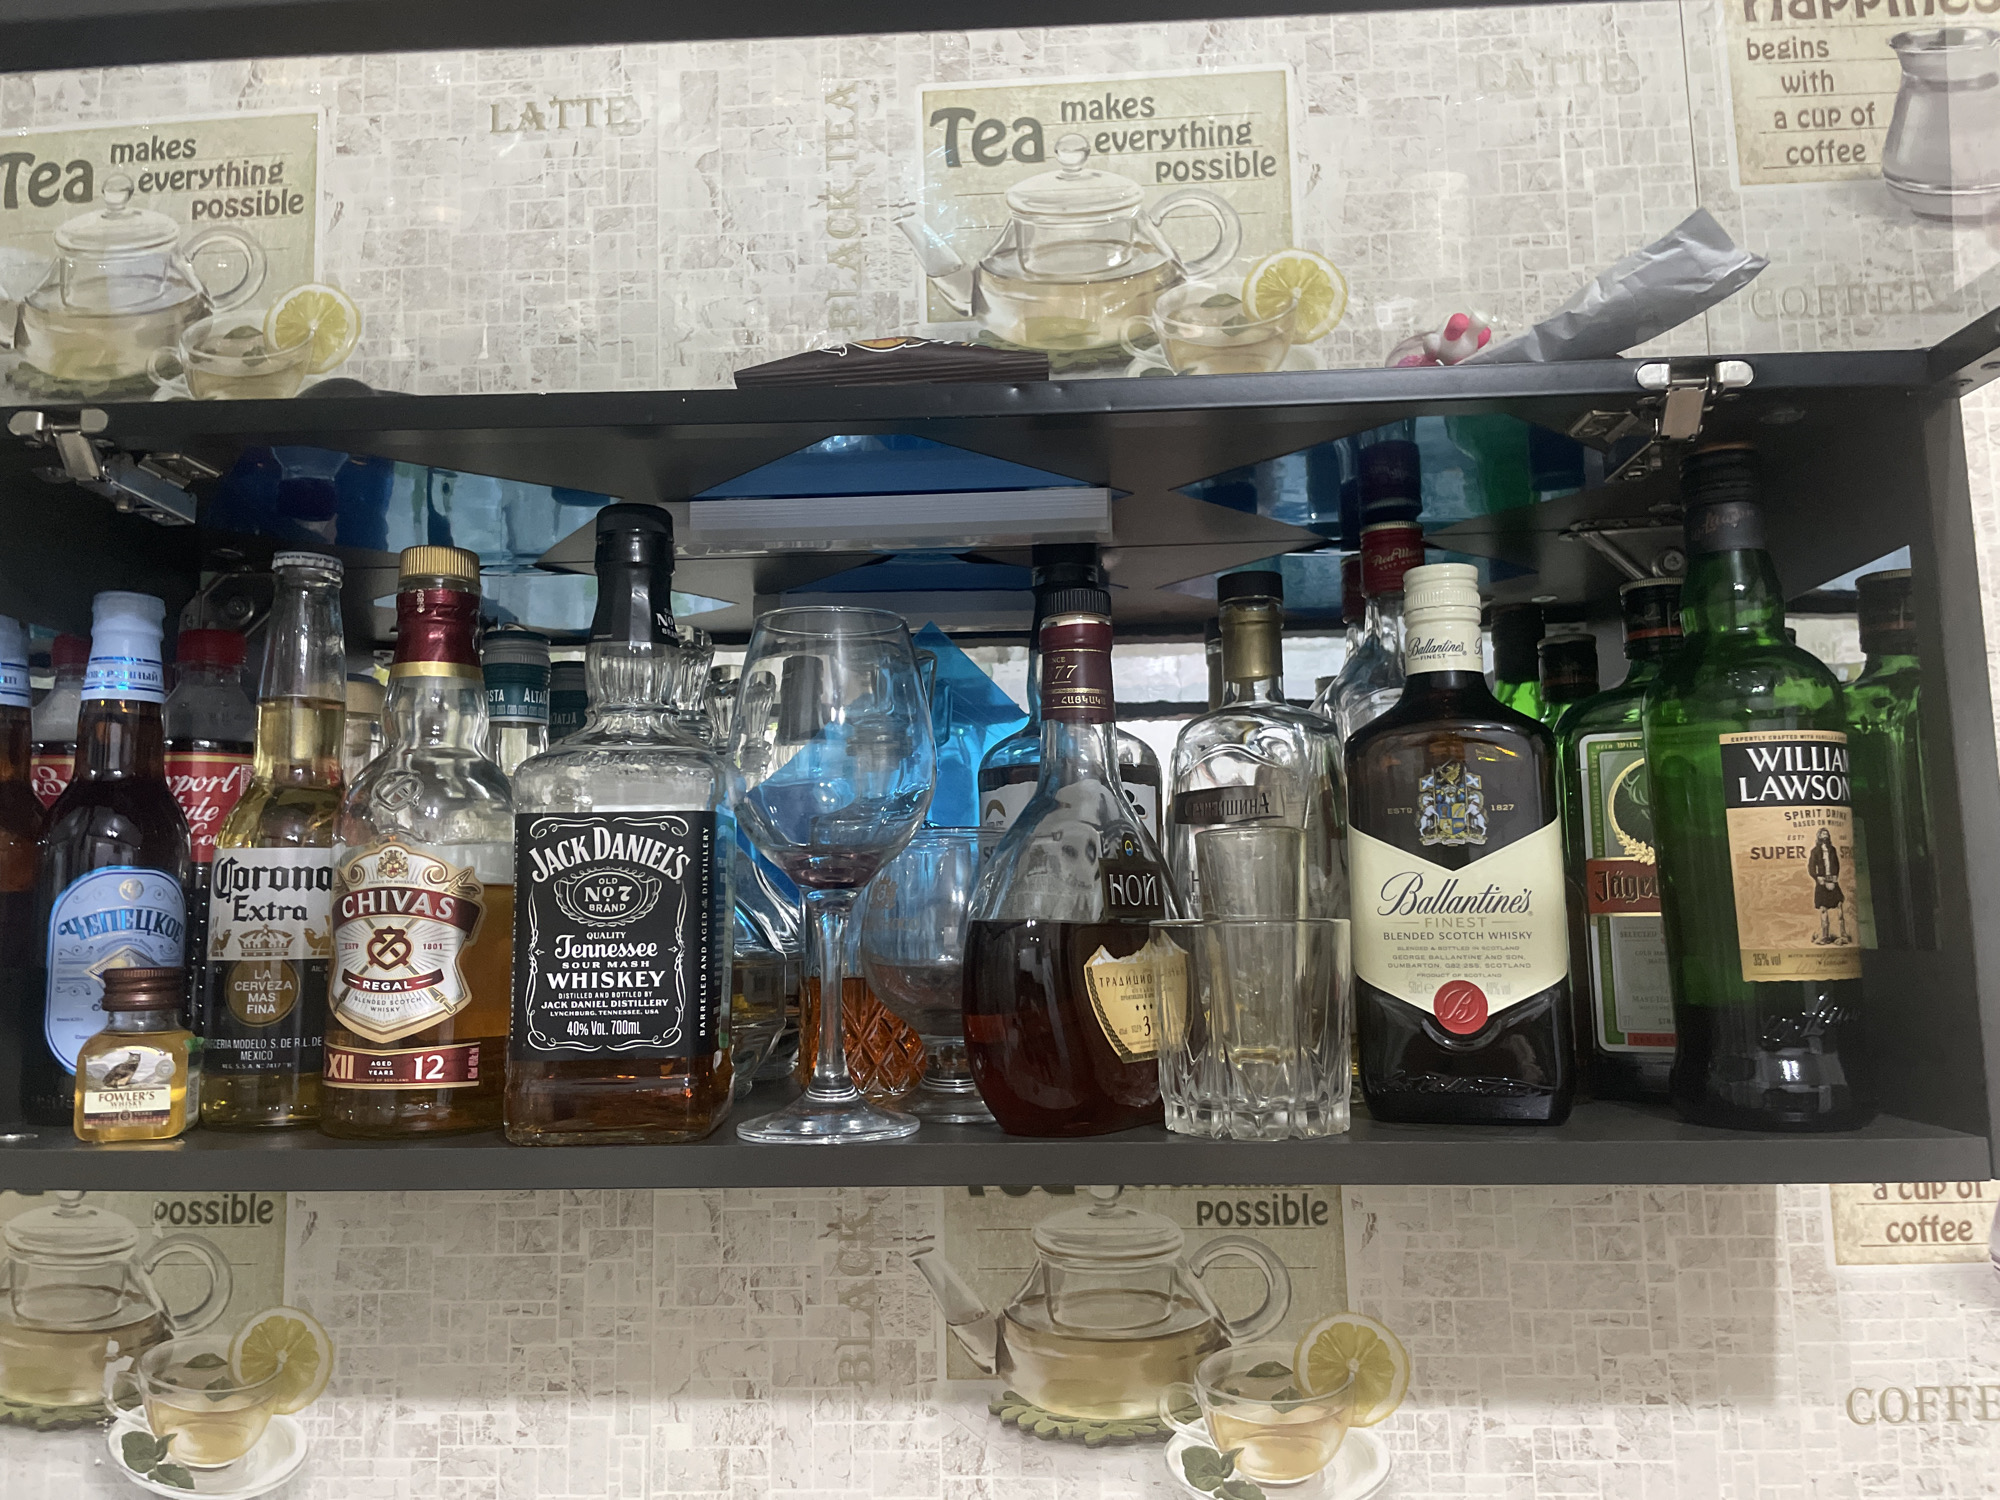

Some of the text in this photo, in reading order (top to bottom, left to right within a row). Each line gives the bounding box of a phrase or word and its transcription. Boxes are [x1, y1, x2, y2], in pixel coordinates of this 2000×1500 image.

[1746, 37, 1830, 62] begins
[1781, 71, 1835, 94] with
[488, 96, 640, 135] LATTE
[1061, 93, 1155, 122] makes
[1774, 103, 1876, 132] a cup of
[930, 107, 1045, 168] Tea
[1094, 119, 1252, 156] everything
[110, 137, 197, 164] makes
[1785, 140, 1867, 167] coffee
[137, 160, 284, 195] everything
[1155, 151, 1277, 183] possible
[191, 189, 304, 221] possible
[825, 82, 862, 331] BLACK TEA
[1420, 653, 1446, 661] FINEST
[1491, 803, 1514, 812] 1827
[1784, 808, 1822, 821] SPIRIT
[529, 827, 691, 883] JACK DANIEL'S
[701, 826, 709, 895] DISTILLERY
[1750, 846, 1807, 860] SUPER
[213, 856, 333, 902] Corona
[598, 877, 618, 885] OLD
[1108, 871, 1159, 907] НОЙ
[341, 889, 456, 919] CHIVAS
[1377, 871, 1532, 917] Ballantine's
[232, 894, 308, 922] Extra
[589, 903, 626, 914] BRAND
[57, 908, 183, 945] ЧЕПЕЦКОЕ
[700, 911, 708, 942] AGED
[1425, 917, 1487, 929] FINEST
[554, 934, 658, 960] Tennessee
[586, 931, 627, 941] QUALITY
[1383, 931, 1532, 941] BLENDED SCOTCH WHISKY
[562, 960, 650, 969] SOUR MASH
[700, 946, 708, 970] AND
[1753, 953, 1770, 967] 35%
[1770, 953, 1782, 966] vol
[234, 981, 293, 991] CERVEZA
[254, 970, 272, 979] LA
[362, 980, 412, 991] REGAL
[546, 970, 666, 989] WHISKEY
[248, 992, 276, 1003] MAS
[353, 995, 422, 1006] BLENDED SCOTCH
[541, 999, 669, 1009] JACK DANIEL DISTILLERY
[558, 990, 653, 1000] DISTILLED AND BOTTLED BY
[699, 973, 708, 1036] BARRELED
[246, 1004, 276, 1014] FINA
[567, 1021, 589, 1036] 40%
[1142, 1015, 1152, 1037] 3
[233, 1038, 267, 1049] MODELO
[280, 1038, 292, 1049] DE
[311, 1036, 323, 1047] DE
[240, 1050, 274, 1061] MEXICO
[327, 1054, 354, 1080] XII
[413, 1054, 445, 1081] 12
[98, 1091, 155, 1103] FOWLER'S
[153, 1193, 274, 1227] possible
[1196, 1194, 1328, 1228] possible
[1886, 1215, 1974, 1244] coffee
